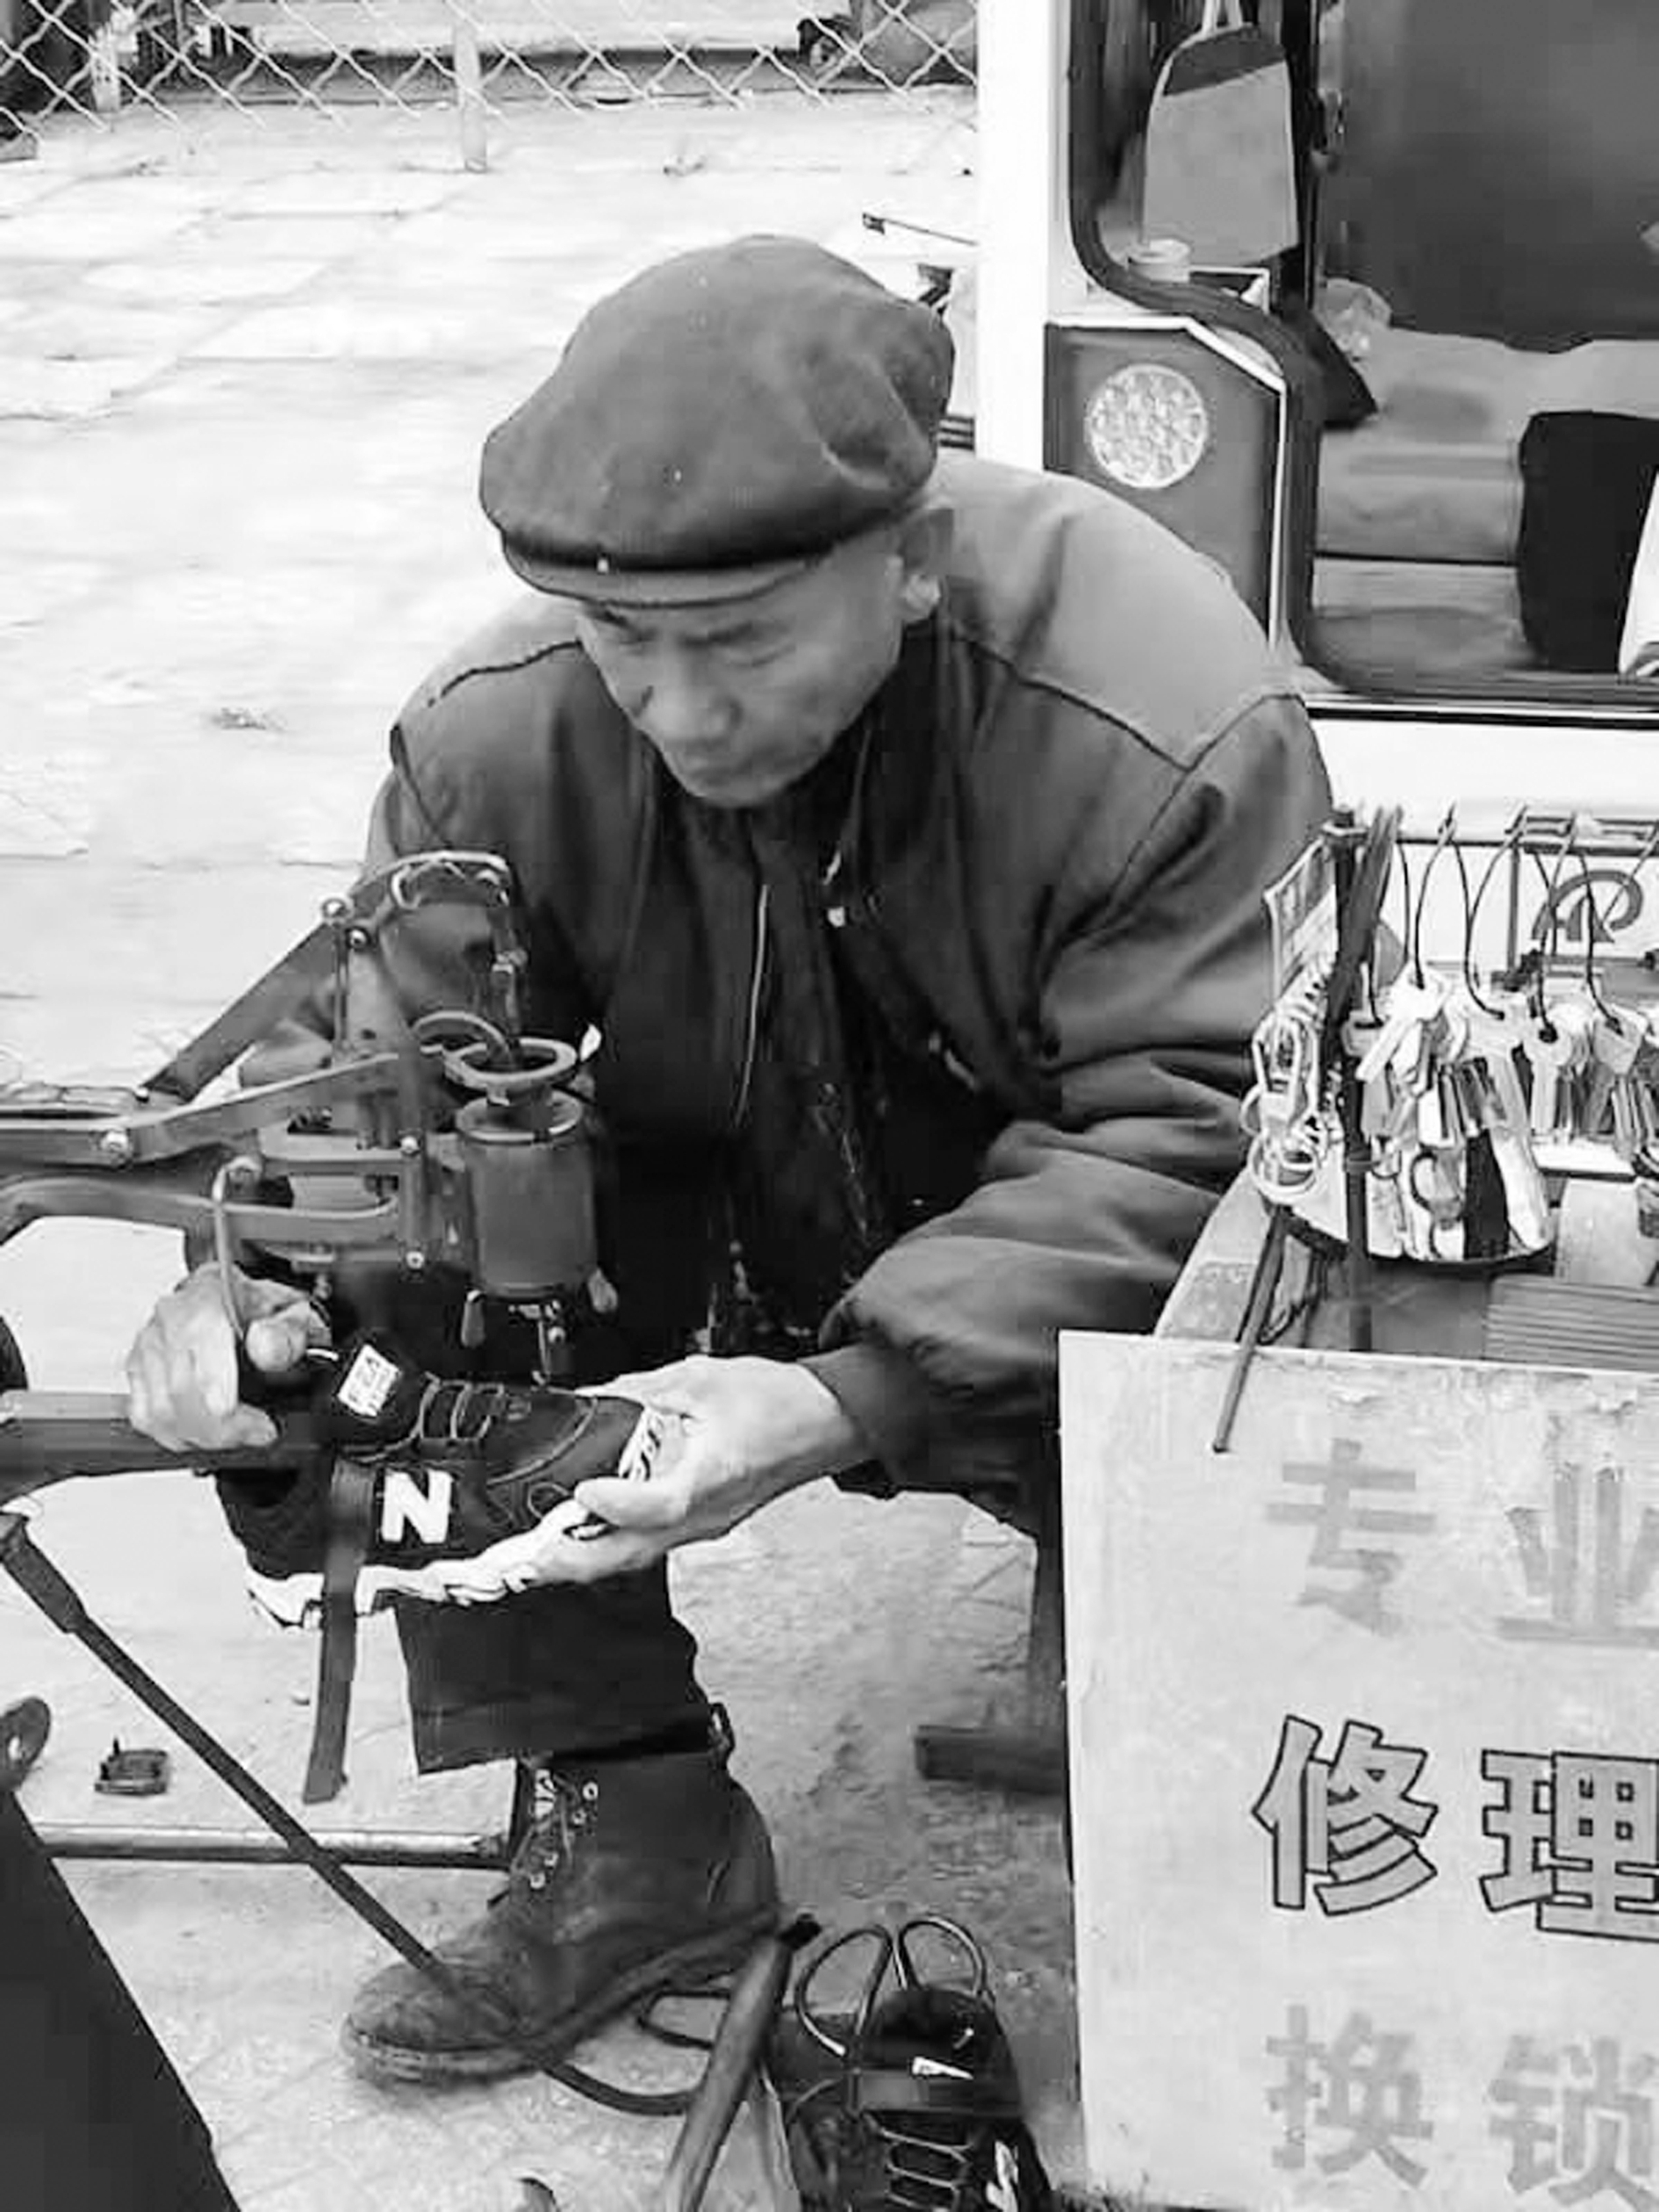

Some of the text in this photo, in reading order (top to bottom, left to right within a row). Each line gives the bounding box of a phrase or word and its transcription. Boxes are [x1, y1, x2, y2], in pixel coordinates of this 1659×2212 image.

[381, 1469, 454, 1544] N
[1265, 1437, 1659, 1649] 专业
[1251, 1713, 1659, 1943] 修理
[1266, 2004, 1659, 2212] 换锁
